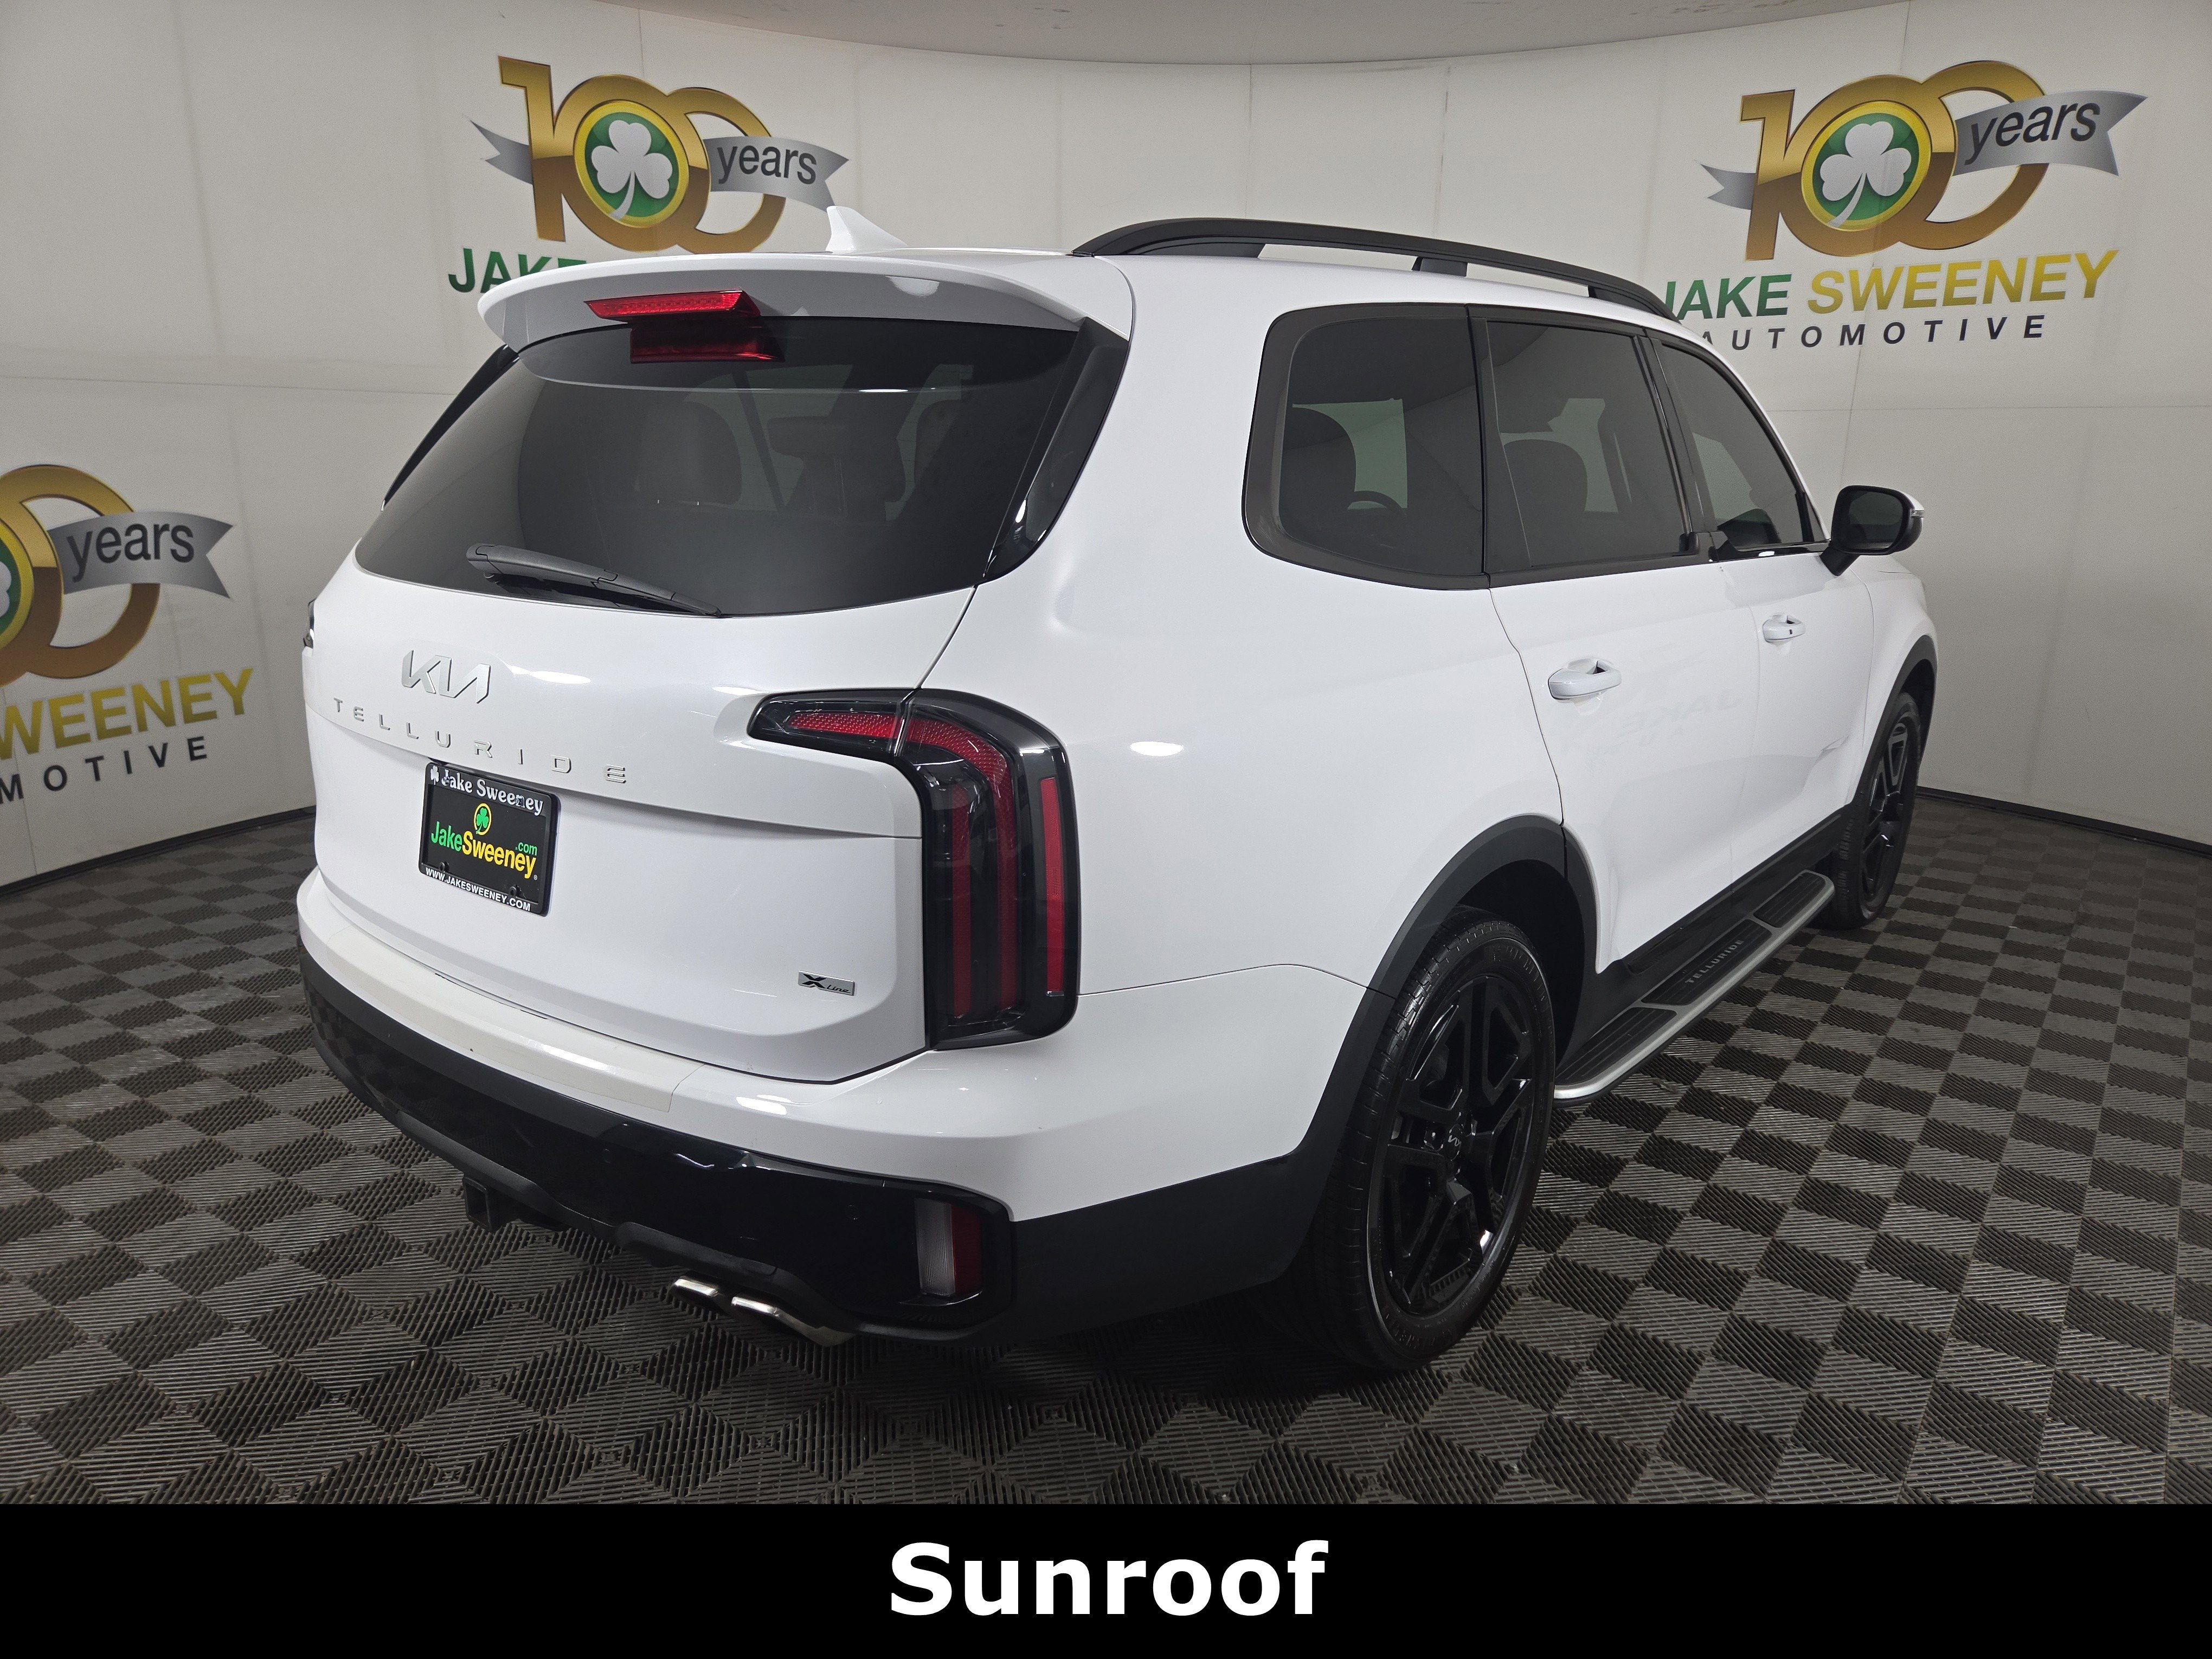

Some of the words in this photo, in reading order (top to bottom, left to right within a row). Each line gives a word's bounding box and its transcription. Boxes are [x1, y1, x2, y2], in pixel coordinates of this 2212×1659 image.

[1964, 102, 2100, 165] years
[717, 143, 817, 185] years
[448, 248, 587, 293] JAK
[1808, 250, 2119, 315] SWEENEY
[67, 523, 195, 583] years
[401, 650, 491, 704] KIA
[333, 698, 627, 783] TELLURIDE
[441, 769, 473, 793] Jake
[476, 779, 543, 815] Sweeney
[431, 821, 536, 879] JakeSweeney
[426, 867, 531, 911] WWW.JAKESWEENEY.COM
